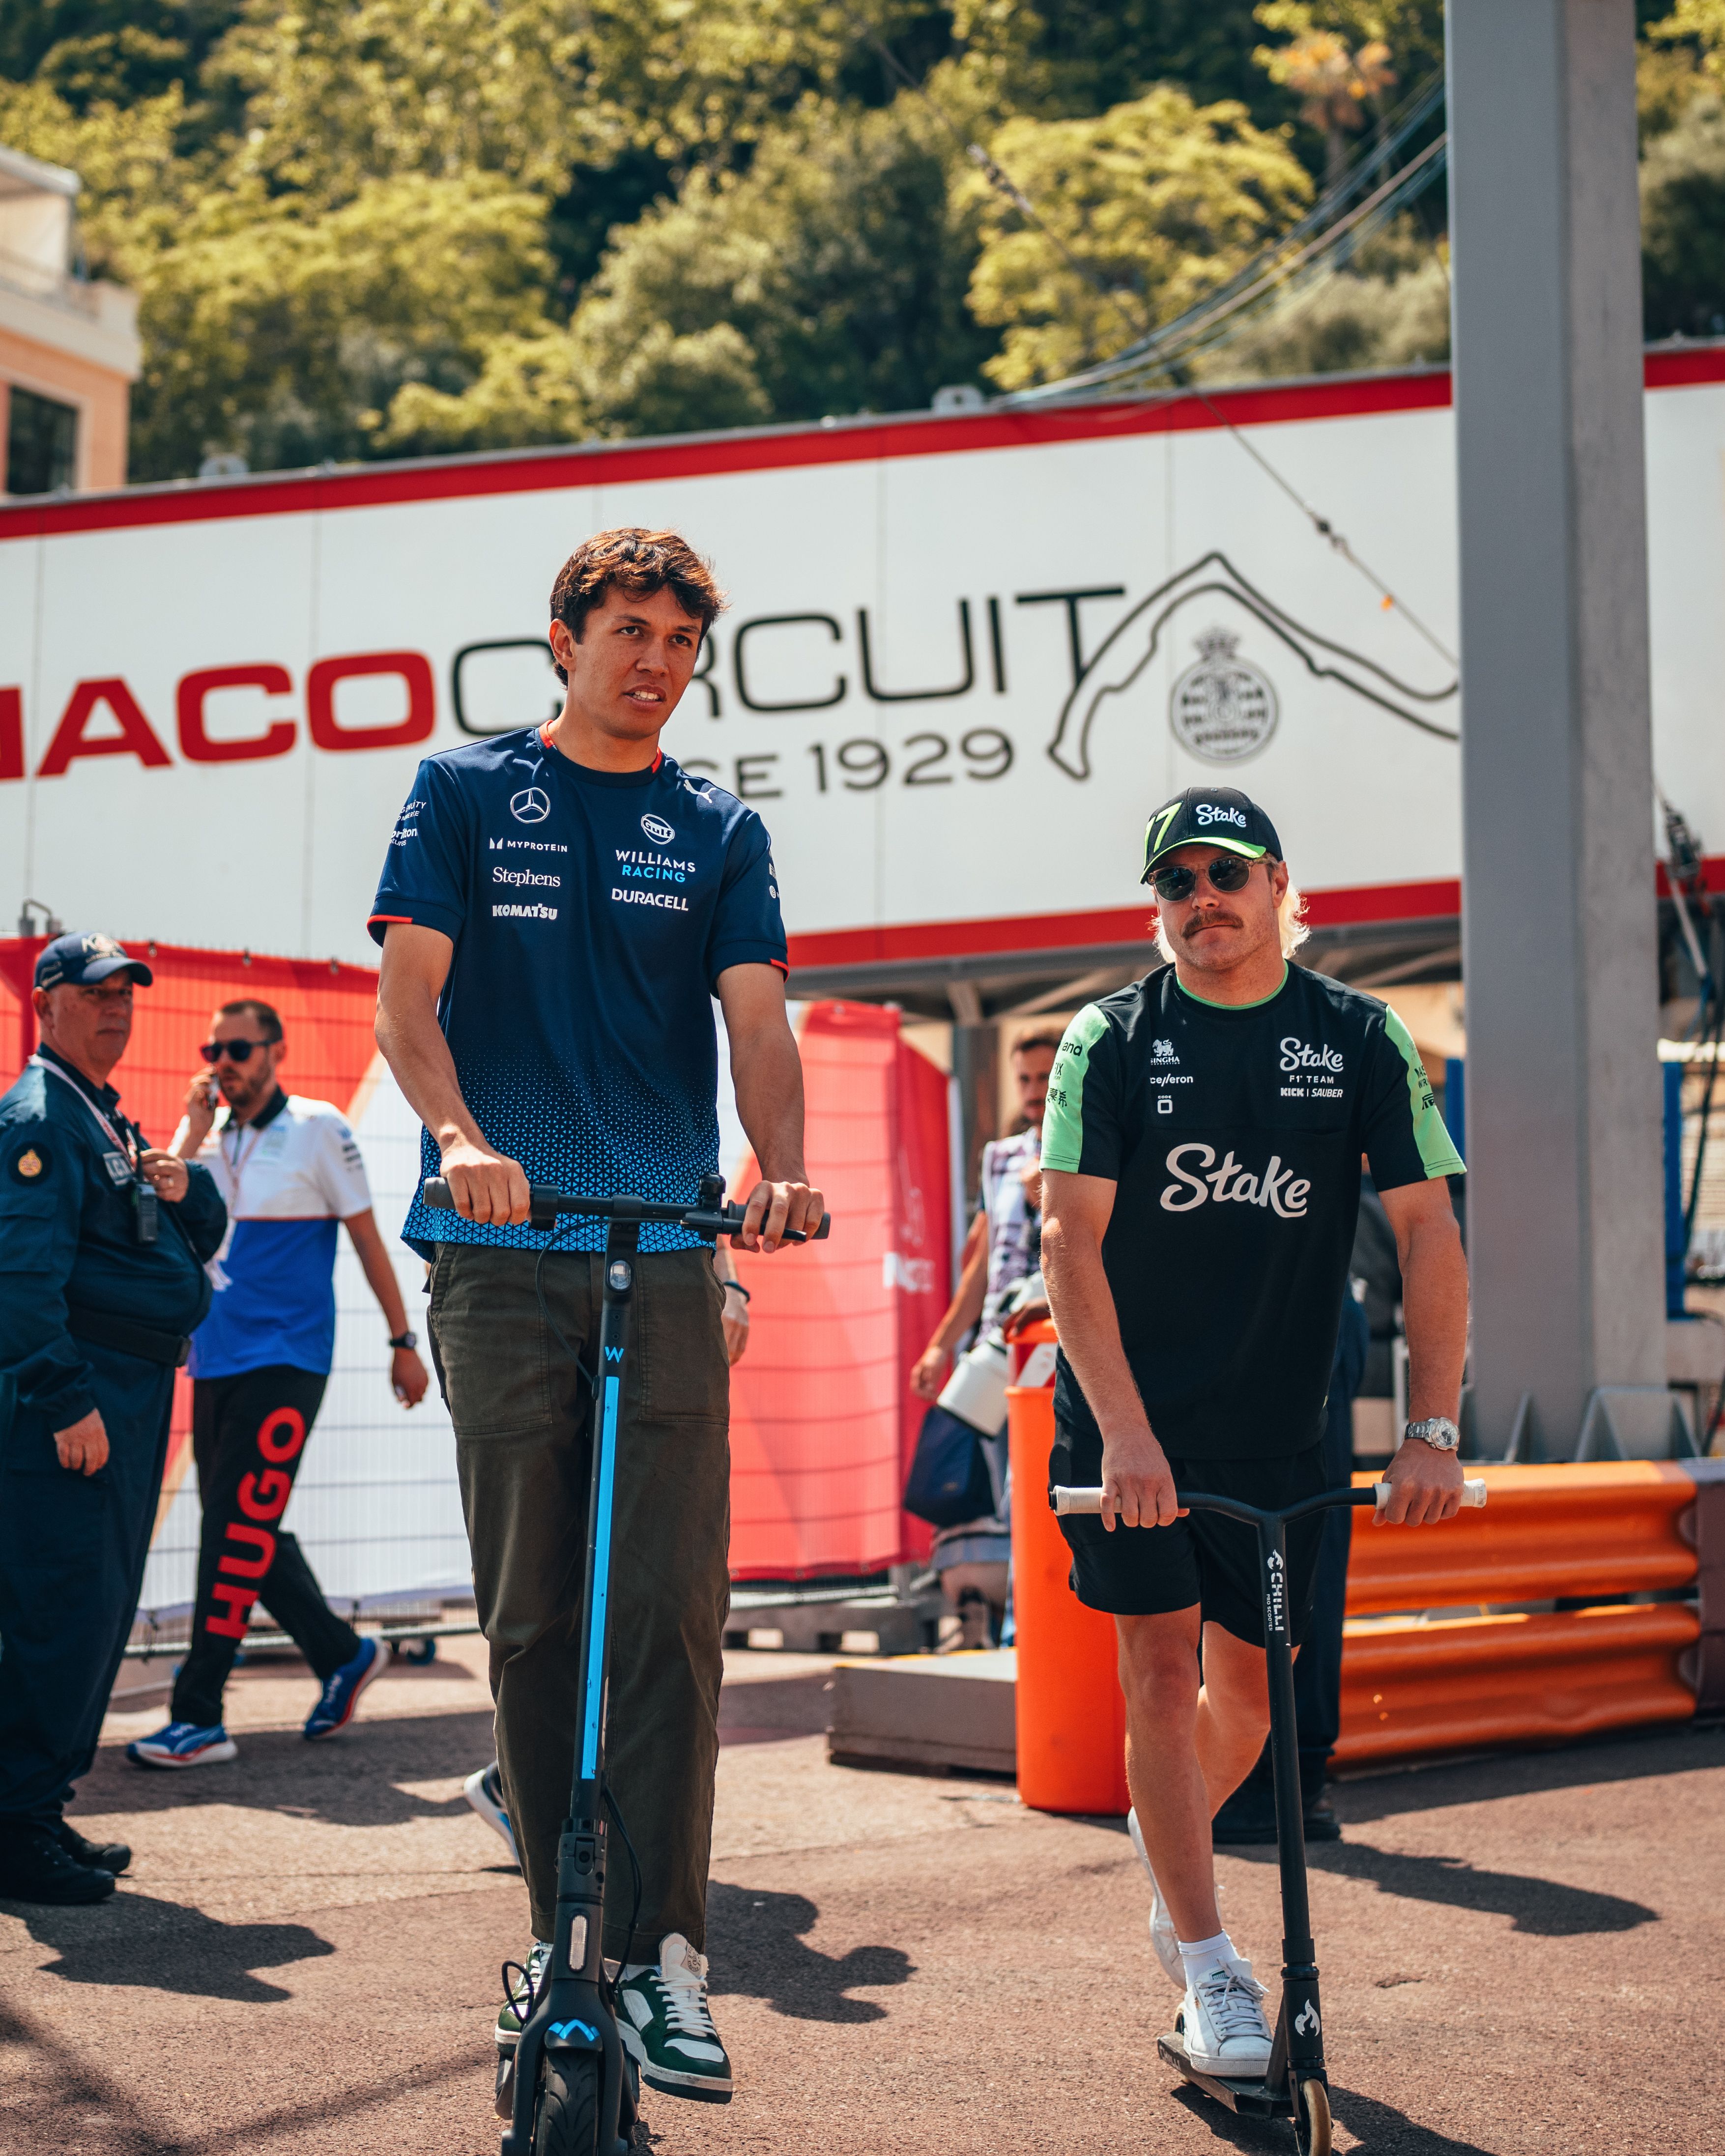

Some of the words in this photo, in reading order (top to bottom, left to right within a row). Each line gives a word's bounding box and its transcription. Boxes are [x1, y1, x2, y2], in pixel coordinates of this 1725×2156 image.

[0, 649, 435, 781] ACO
[810, 727, 1013, 794] 1929
[1196, 804, 1246, 828] Stake
[643, 819, 672, 838] Gulf
[507, 840, 568, 852] MYPROTEIN
[615, 850, 696, 872] WILLIAMS
[492, 866, 561, 887] Stephens
[622, 864, 686, 883] RACING
[611, 888, 689, 911] DURACELL
[492, 903, 558, 920] KOMATSU
[1280, 1037, 1344, 1072] Stake
[1306, 1075, 1334, 1084] TEAM
[1280, 1088, 1304, 1097] KICK
[1311, 1088, 1344, 1098] SAUBER
[1160, 1143, 1311, 1218] Stake
[204, 1406, 306, 1639] HUGO
[1271, 1572, 1284, 1631] CHILLI
